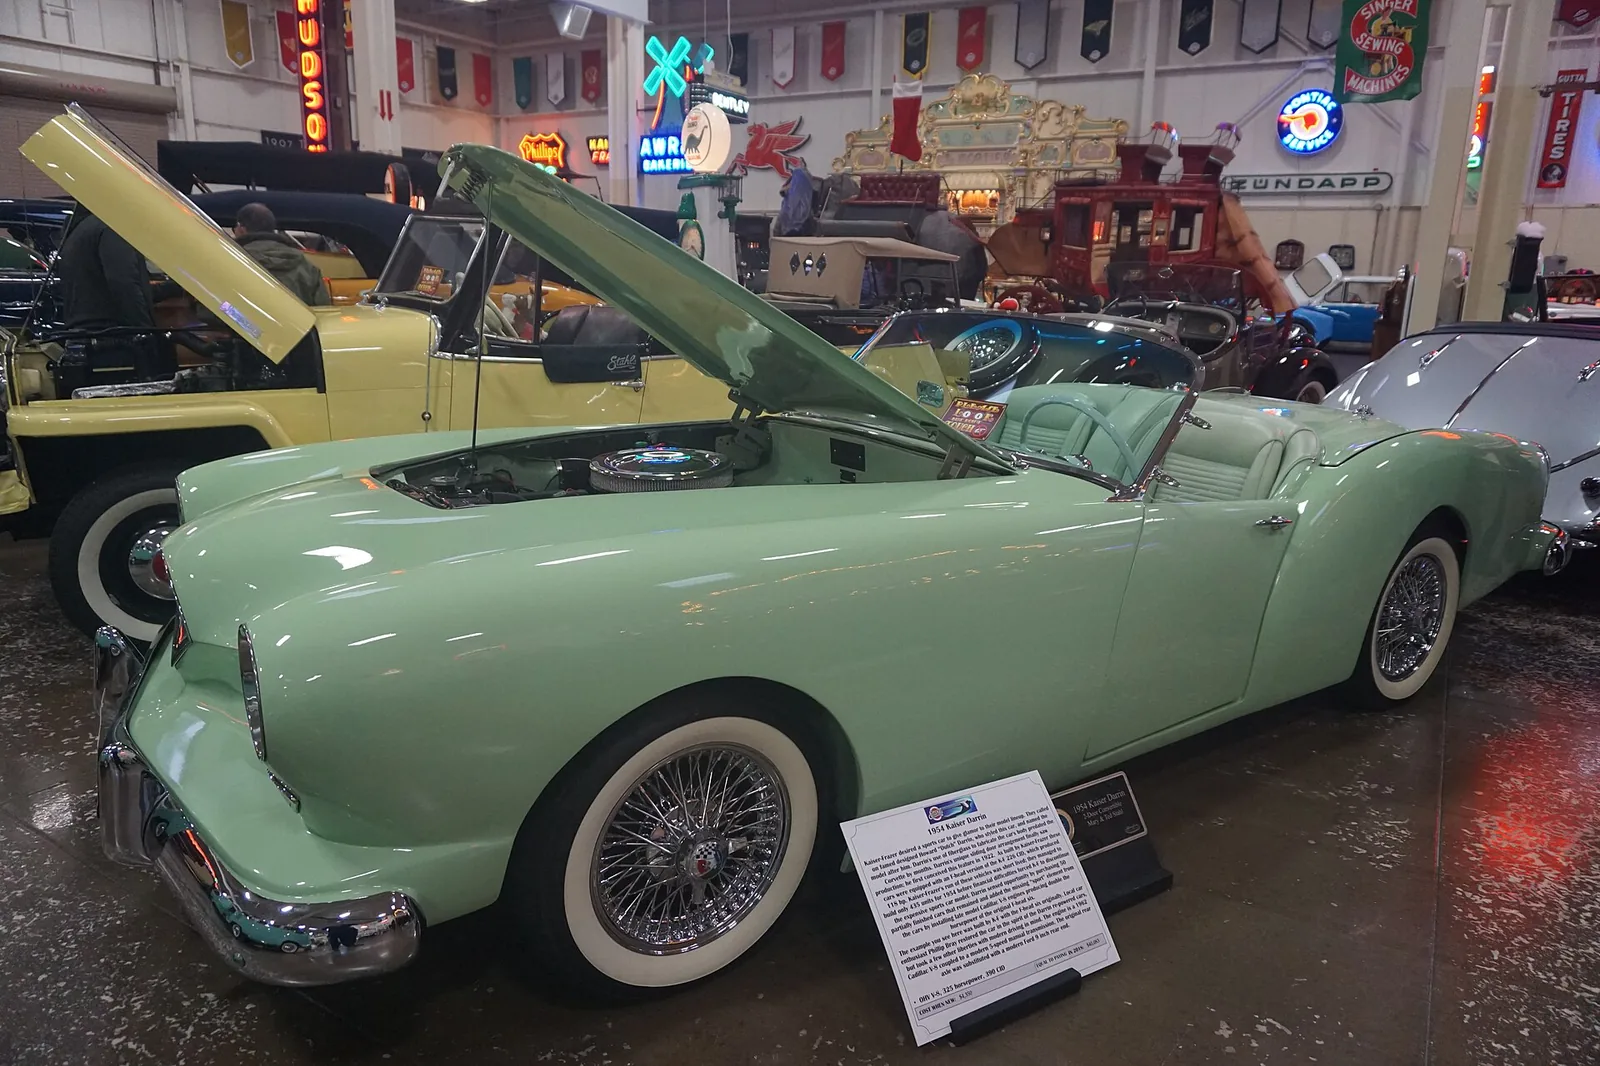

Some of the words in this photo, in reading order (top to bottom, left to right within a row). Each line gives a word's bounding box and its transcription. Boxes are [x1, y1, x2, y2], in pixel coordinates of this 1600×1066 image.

[1356, 32, 1404, 54] SEWING
[296, 0, 327, 152] HUDSO
[1348, 64, 1410, 92] MACHINES
[1558, 74, 1585, 83] GUTTA
[712, 92, 750, 114] BENTLEY
[1283, 92, 1336, 114] PONTIAC
[265, 136, 292, 148] 1907
[1283, 130, 1334, 150] SERVICE
[1550, 92, 1576, 159] TIRES
[523, 142, 558, 164] Phillips
[640, 136, 684, 157] AWR
[1232, 177, 1381, 190] ZÜNDAPP
[954, 408, 994, 422] LOOK
[955, 401, 999, 413] PLEASE
[1073, 802, 1087, 814] 1954
[1088, 797, 1107, 809] Kaiser
[1106, 790, 1126, 801] Darrin
[928, 825, 945, 835] 1954
[946, 820, 965, 830] Kaiser
[966, 814, 987, 824] Darrin
[864, 853, 897, 866] Kaiser-Frazer
[898, 846, 917, 856] desired
[963, 828, 978, 837] glamor
[871, 871, 887, 880] model
[912, 859, 932, 867] Darrin's
[948, 846, 971, 856] fiberglass
[977, 838, 997, 847] fabricate
[1028, 821, 1046, 832] predated
[879, 860, 896, 870] famed
[896, 853, 918, 864] designed
[918, 848, 937, 857] Howard
[1026, 816, 1040, 824] named
[884, 875, 905, 884] Corvette
[933, 860, 953, 869] Darrin's
[970, 848, 986, 857] sliding
[998, 836, 1025, 848] arrangement
[924, 868, 948, 880] conceived
[958, 860, 975, 869] feature
[1020, 836, 1048, 848] Kaiser-Frazer
[908, 887, 944, 902] Kaiser-Frazer's
[974, 871, 992, 879] vehicles
[1037, 848, 1057, 858] managed
[909, 882, 932, 893] equipped
[950, 870, 966, 879] F-head
[966, 865, 984, 874] version
[1040, 839, 1060, 850] produced
[883, 910, 897, 919] build
[957, 885, 972, 893] before
[973, 877, 993, 888] financial
[994, 870, 1017, 881] difficulties
[1017, 864, 1032, 872] forced
[1046, 852, 1069, 863] discontinue
[891, 922, 912, 934] partially
[913, 914, 933, 926] finished
[956, 898, 979, 910] remained
[990, 890, 1003, 899] added
[1012, 881, 1030, 890] missing
[1046, 869, 1063, 878] element
[904, 909, 928, 920] expensive
[971, 888, 987, 897] Darrin
[987, 882, 1003, 891] sensed
[1004, 874, 1029, 885] opportunity
[1036, 863, 1060, 875] purchasing
[931, 916, 955, 928] installing
[965, 906, 980, 916] model
[980, 901, 998, 910] Cadillac
[1008, 892, 1025, 900] engines
[1026, 882, 1048, 895] producing
[1048, 878, 1062, 886] double
[901, 951, 928, 965] enthusiast
[928, 946, 945, 955] Phillip
[958, 932, 979, 944] restored
[1011, 916, 1023, 924] spirit
[1037, 906, 1052, 914] Darrin
[1052, 896, 1076, 908] re-powered
[910, 942, 931, 953] example
[1019, 903, 1034, 912] F-head
[1063, 888, 1076, 896] Local
[950, 916, 978, 930] horsepower
[993, 903, 1011, 914] original
[1011, 898, 1027, 907] F-head
[908, 969, 928, 980] Cadillac
[939, 957, 959, 968] coupled
[970, 947, 989, 957] modern
[989, 938, 1008, 949] 5-speed
[1008, 931, 1026, 942] manual
[1065, 910, 1082, 920] original
[943, 950, 956, 958] other
[957, 942, 978, 953] liberties
[989, 931, 1007, 941] modern
[1008, 924, 1024, 934] driving
[1052, 908, 1066, 916] engine
[963, 953, 990, 968] substituted
[1005, 942, 1024, 952] modern
[919, 995, 930, 1003] OHV
[942, 985, 954, 993] 325
[986, 969, 996, 977] 390
